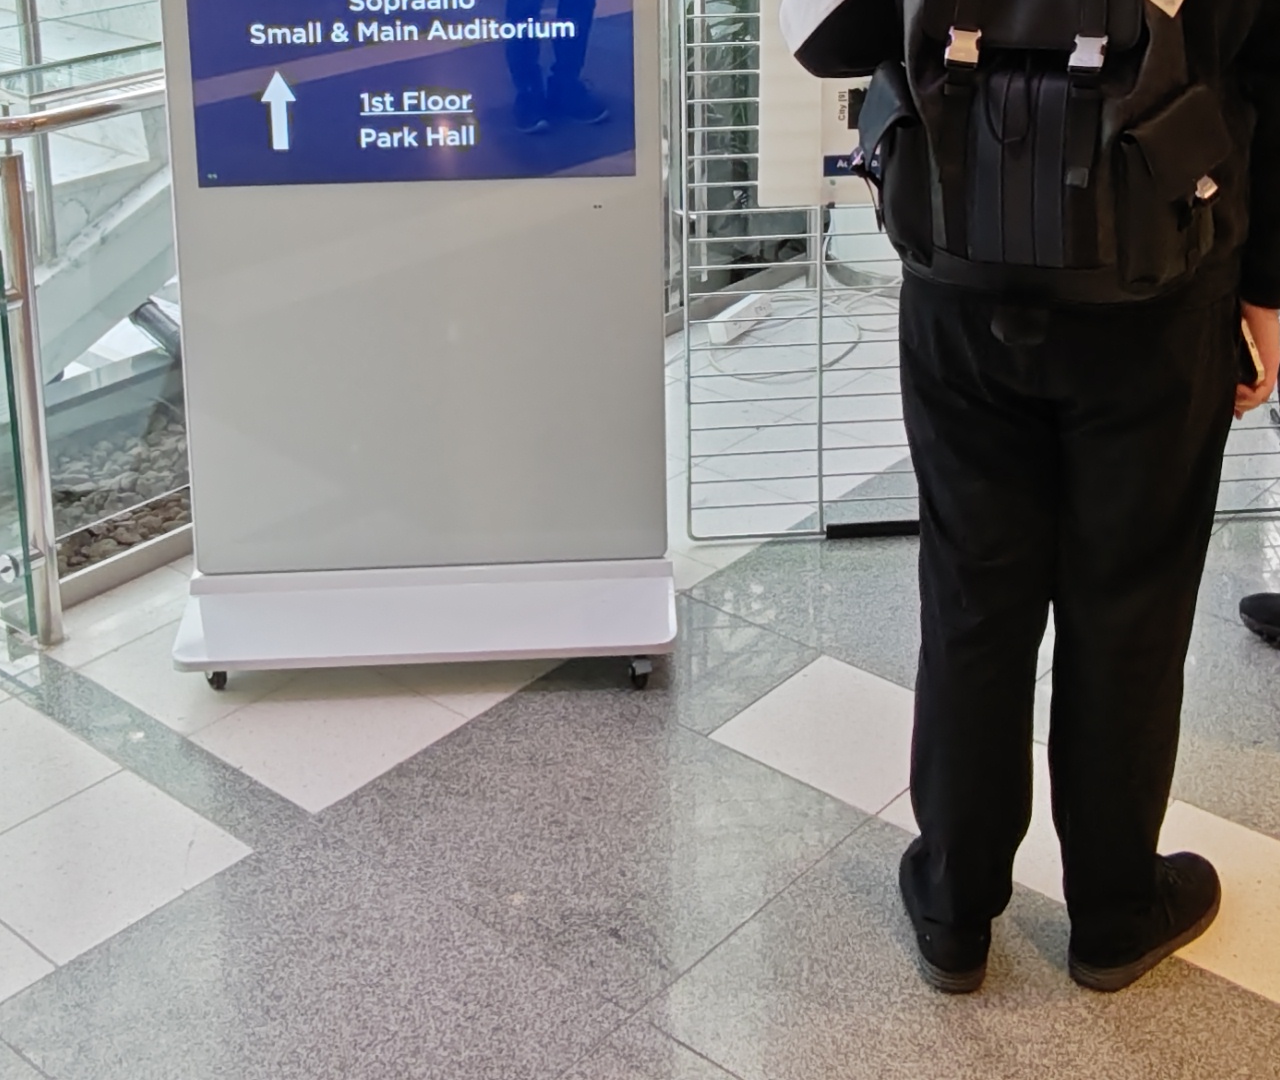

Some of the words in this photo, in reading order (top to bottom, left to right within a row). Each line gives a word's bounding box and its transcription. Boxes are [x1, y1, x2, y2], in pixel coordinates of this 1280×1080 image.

[250, 22, 322, 45] Small
[331, 22, 349, 43] &
[357, 19, 419, 42] Main
[427, 17, 575, 41] Auditorium
[360, 92, 394, 113] 1st
[402, 90, 472, 112] Floor
[360, 125, 418, 148] Park
[426, 124, 475, 147] Hall
